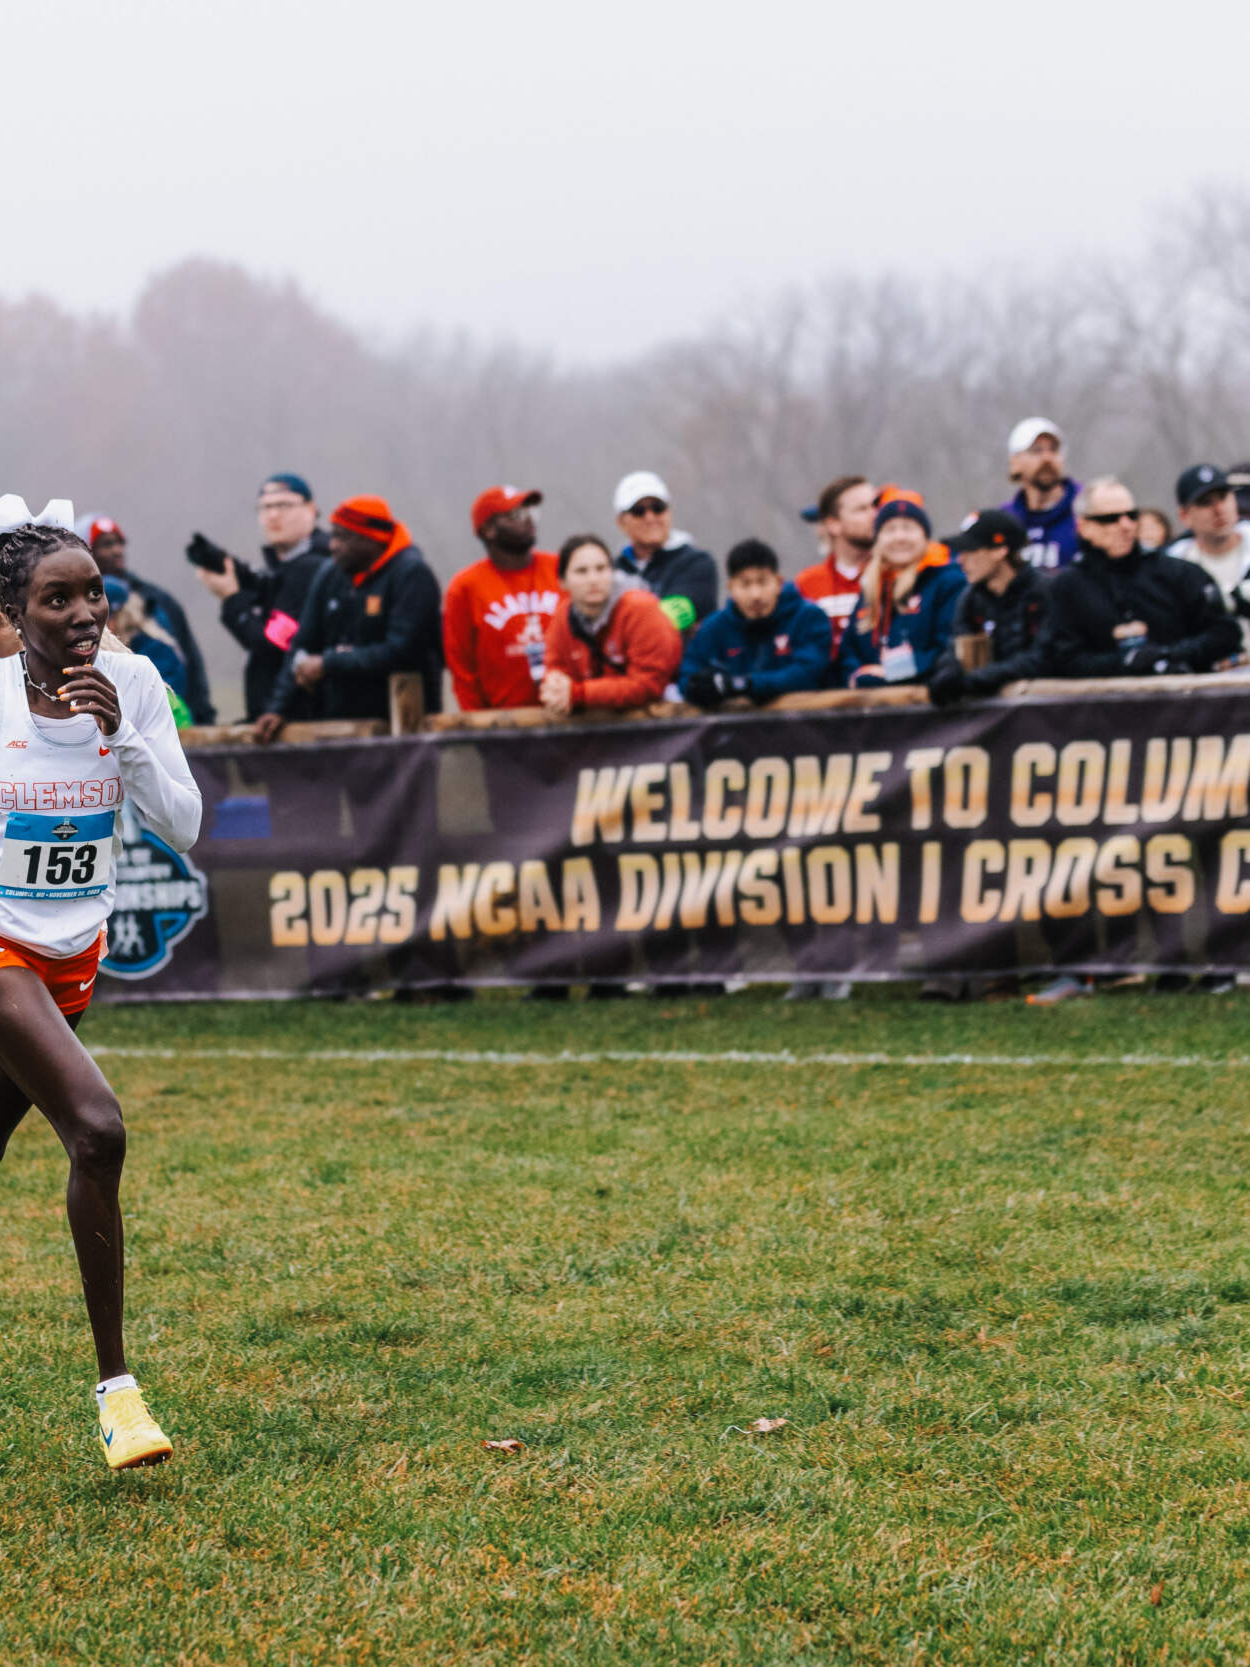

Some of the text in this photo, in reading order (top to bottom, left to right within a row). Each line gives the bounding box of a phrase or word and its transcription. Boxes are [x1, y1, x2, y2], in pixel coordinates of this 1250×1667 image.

[6, 740, 28, 749] ACC
[570, 733, 1250, 846] WELCOME TO COLUM
[23, 844, 98, 885] 153
[269, 865, 419, 947] 2025
[429, 854, 601, 942] NCAA
[614, 841, 900, 932] DIVISION
[919, 841, 943, 924] I
[961, 834, 1195, 924] CROSS
